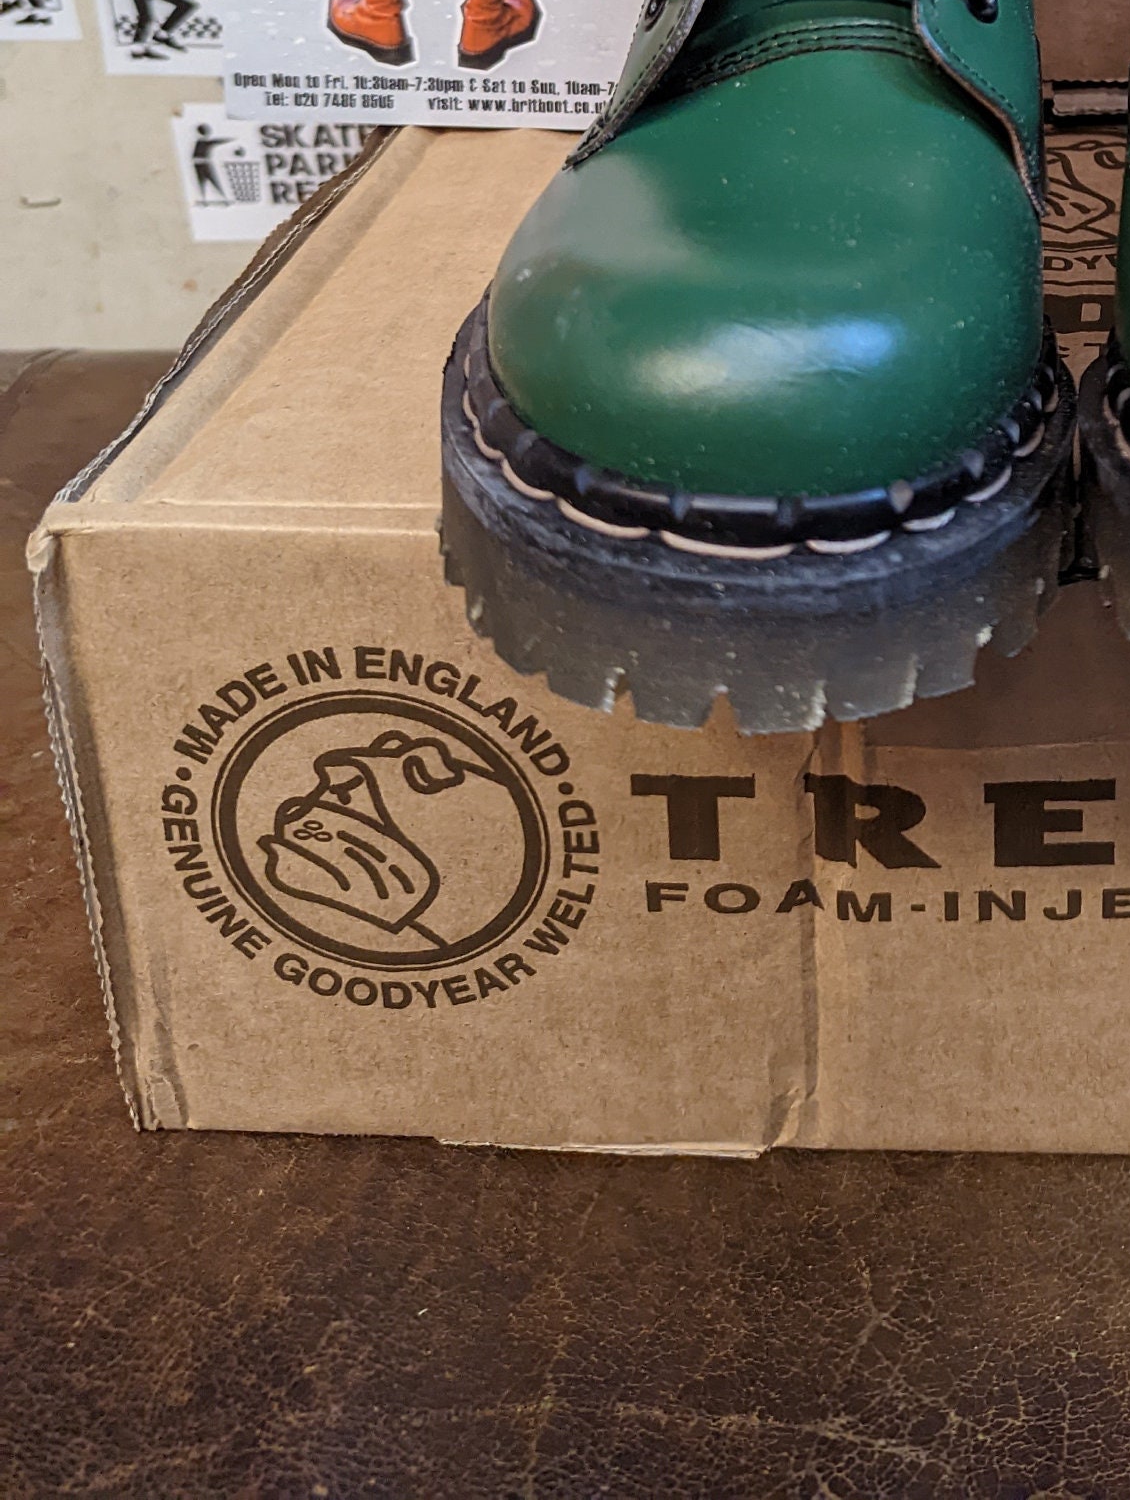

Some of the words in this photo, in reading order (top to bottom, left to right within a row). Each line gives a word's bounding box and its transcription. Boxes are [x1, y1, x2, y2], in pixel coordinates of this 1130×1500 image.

[272, 73, 300, 88] Mon
[306, 74, 320, 89] to
[482, 78, 506, 93] Sat
[512, 80, 525, 94] to
[565, 81, 618, 96] 10am-7
[174, 663, 287, 765] MADE
[287, 646, 342, 686] IN
[355, 646, 571, 776] ENGLAND
[162, 784, 273, 960] GENUINE
[273, 951, 537, 1010] GOODYEAR
[524, 800, 600, 956] WELTED
